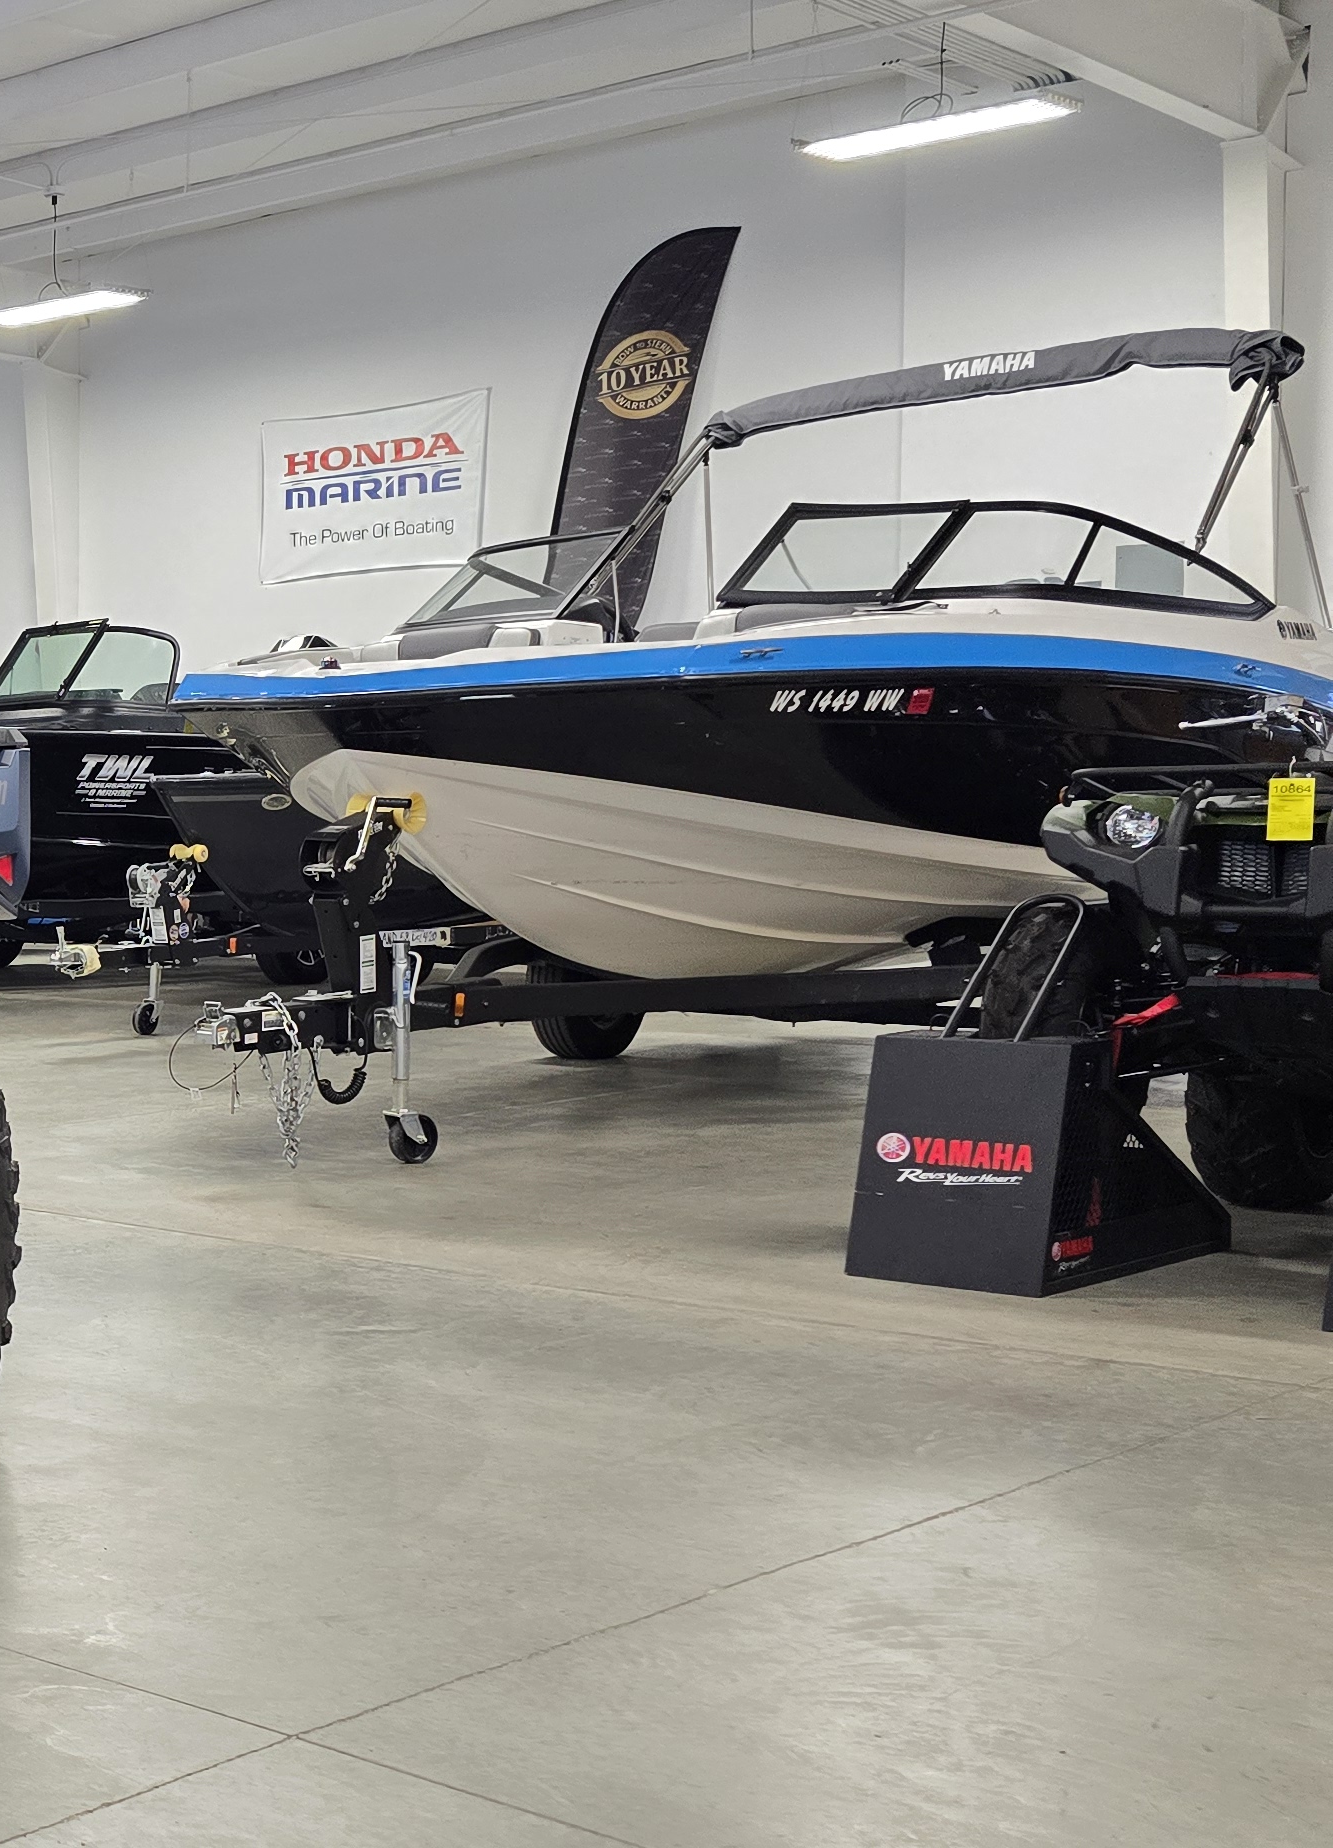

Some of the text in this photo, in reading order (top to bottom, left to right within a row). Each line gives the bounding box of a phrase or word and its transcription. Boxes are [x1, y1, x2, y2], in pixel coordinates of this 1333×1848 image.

[614, 346, 634, 365] BOW
[646, 339, 673, 355] STERN
[943, 351, 1036, 381] YAMAHA
[598, 356, 690, 395] 10 YEAR
[615, 385, 673, 410] WARRANTY
[283, 432, 464, 477] HONDA
[290, 517, 455, 547] The Power Of Boating
[769, 689, 807, 713] WS
[807, 689, 860, 713] 1449
[863, 688, 905, 712] WW
[76, 753, 154, 783] TWL
[1274, 784, 1312, 794] 10864
[912, 1136, 1034, 1173] YAMAHA
[896, 1168, 945, 1183] Revs
